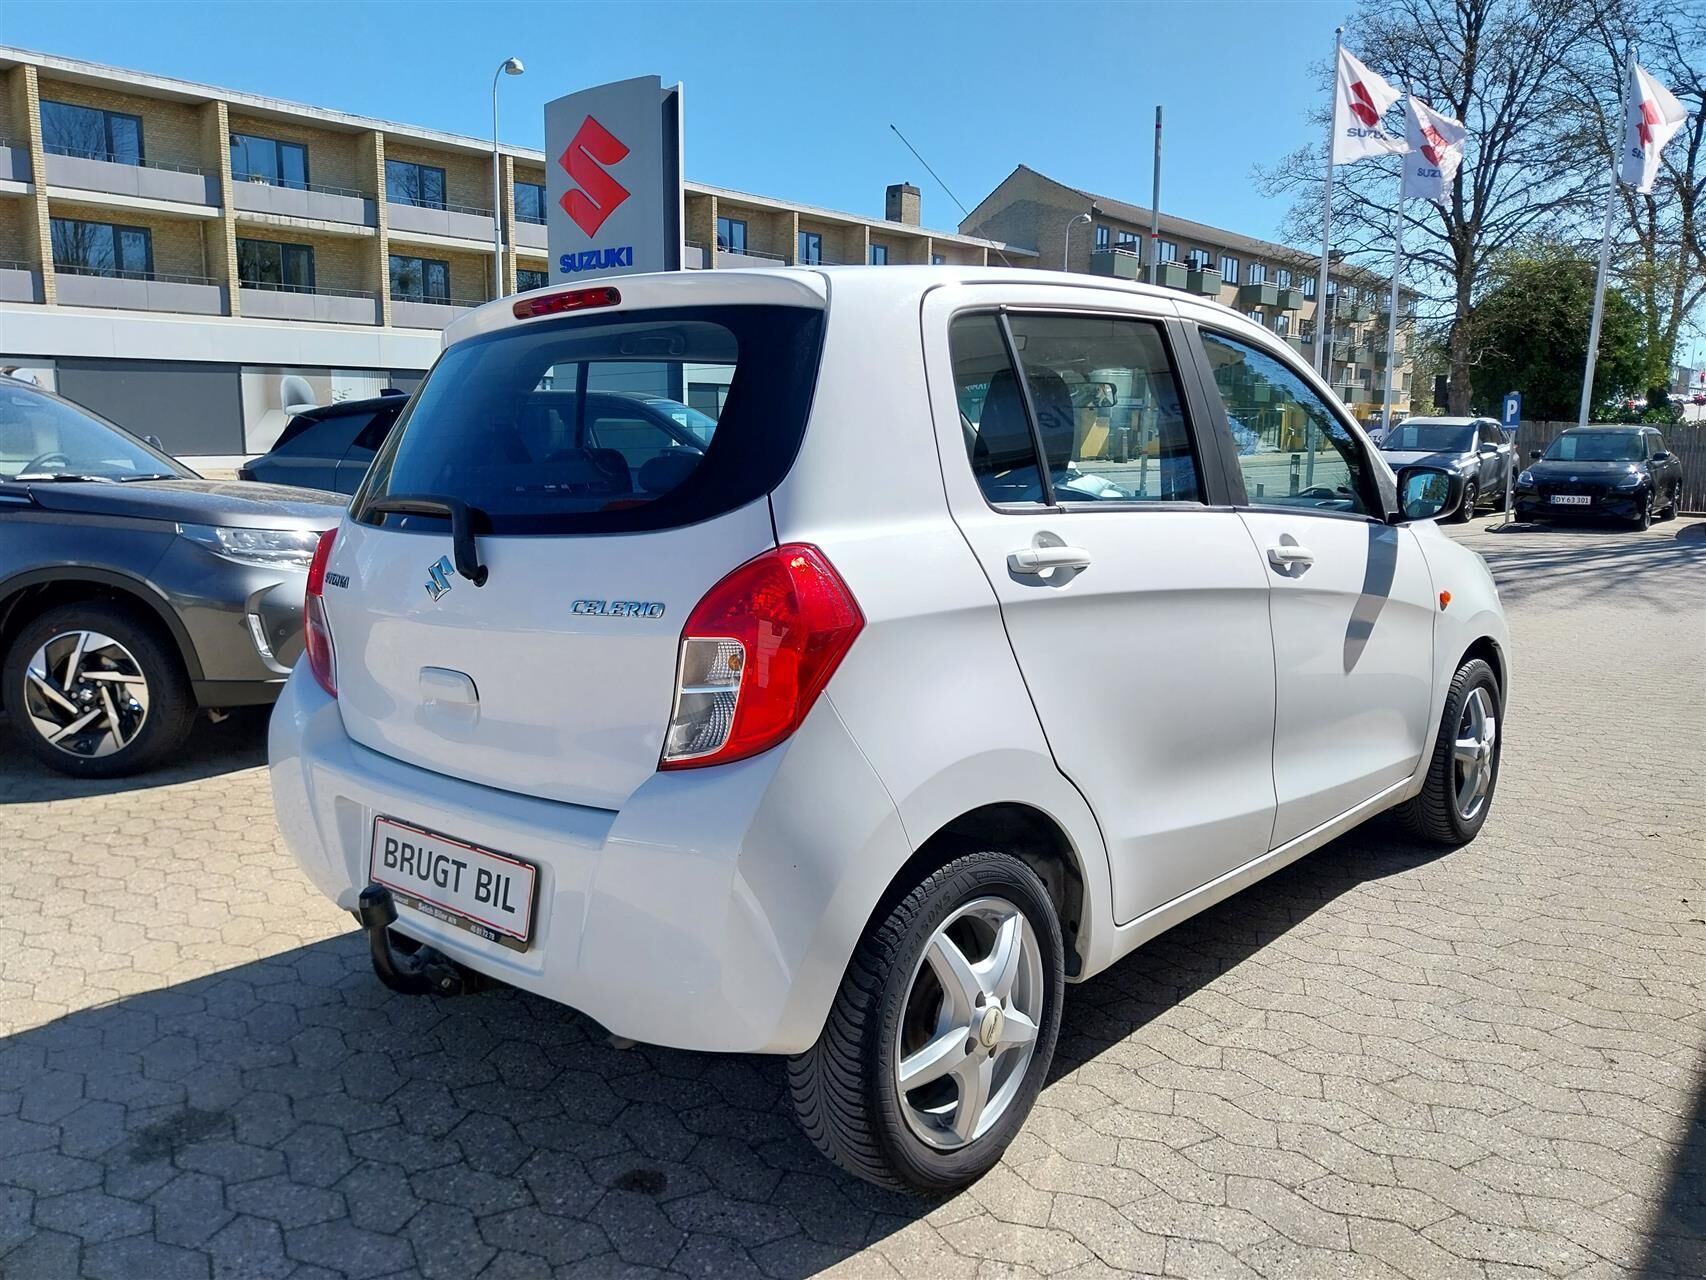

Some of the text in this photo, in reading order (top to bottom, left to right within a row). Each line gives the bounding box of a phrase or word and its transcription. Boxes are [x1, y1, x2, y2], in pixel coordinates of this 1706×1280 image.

[559, 246, 633, 273] SUZUKI
[1505, 399, 1518, 423] P
[1566, 496, 1576, 504] 63
[1576, 496, 1589, 504] 301
[570, 599, 666, 619] CELERIO
[383, 836, 516, 914] BRUGT BIL
